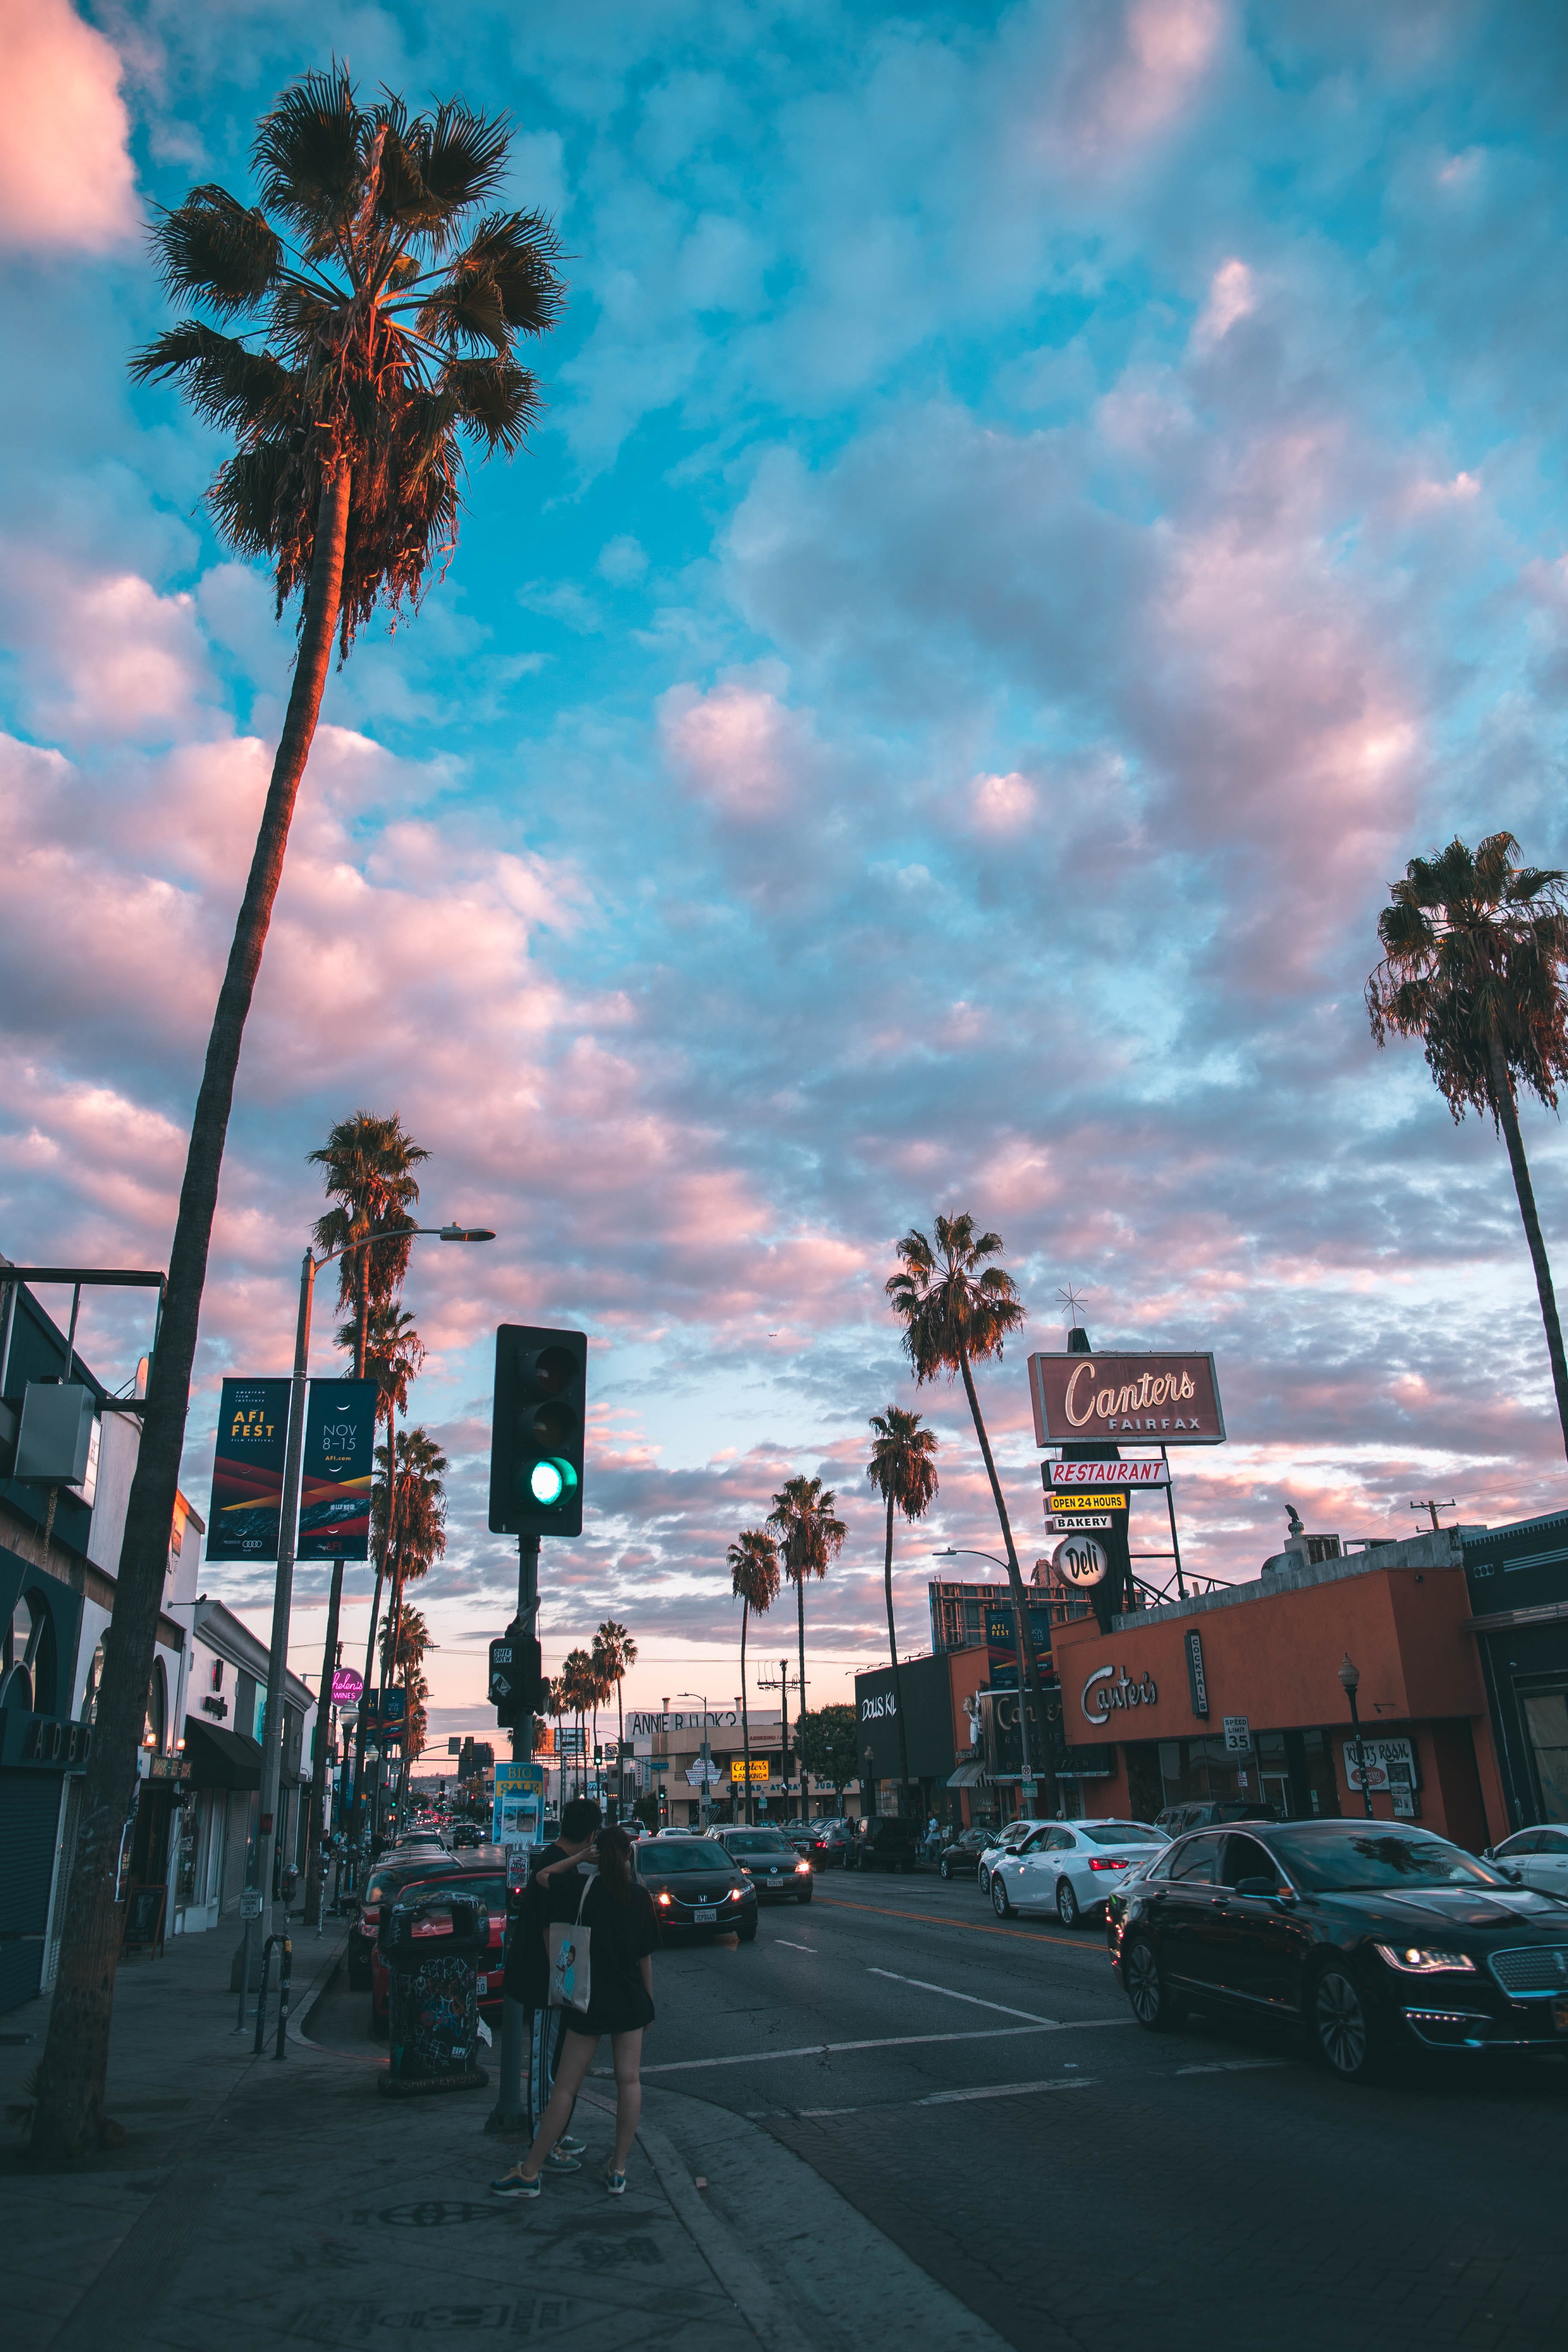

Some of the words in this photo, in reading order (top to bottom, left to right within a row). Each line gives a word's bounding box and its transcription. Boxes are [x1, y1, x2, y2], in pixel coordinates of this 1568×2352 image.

[1065, 1362, 1195, 1427] Canters
[233, 1411, 264, 1422] AFI
[1109, 1418, 1200, 1431] FAIRFAX
[232, 1425, 274, 1436] FEST
[324, 1425, 357, 1436] NOV
[1054, 1462, 1164, 1482] RESTAURANT
[1054, 1499, 1076, 1508] OPEN
[1078, 1498, 1092, 1507] 24
[1094, 1496, 1122, 1507] HOURS
[1058, 1517, 1107, 1528] BAKERY
[1066, 1540, 1099, 1579] Deli
[332, 1672, 363, 1690] helen's
[1192, 1639, 1206, 1710] COCKTAILS
[1081, 1665, 1158, 1724] Canter's
[633, 1713, 670, 1735] ANNIE
[675, 1713, 683, 1730] R
[1228, 1735, 1248, 1749] 35
[1378, 1743, 1409, 1763] ROOM
[508, 1767, 533, 1779] BIG
